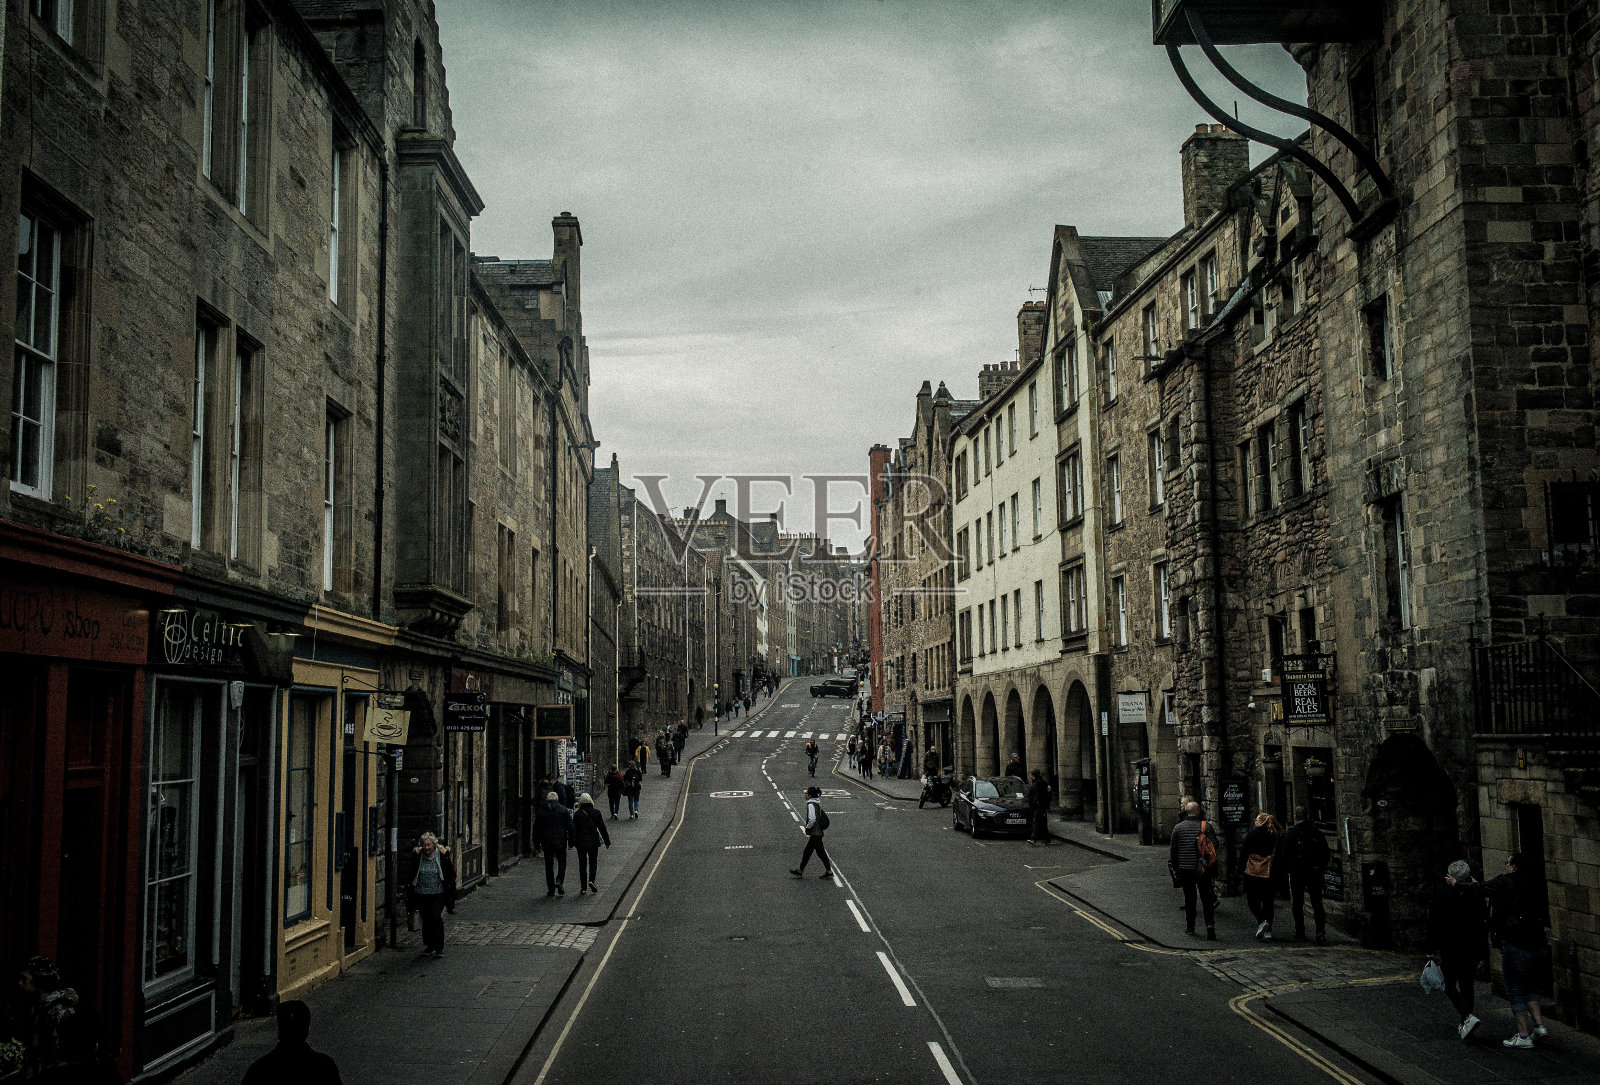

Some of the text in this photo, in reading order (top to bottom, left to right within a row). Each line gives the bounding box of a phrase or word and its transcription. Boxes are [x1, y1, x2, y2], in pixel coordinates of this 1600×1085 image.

[64, 592, 101, 657] shop
[191, 611, 244, 648] Celtic
[185, 640, 223, 664] design
[1295, 697, 1317, 706] REAL
[1295, 705, 1318, 713] ALES
